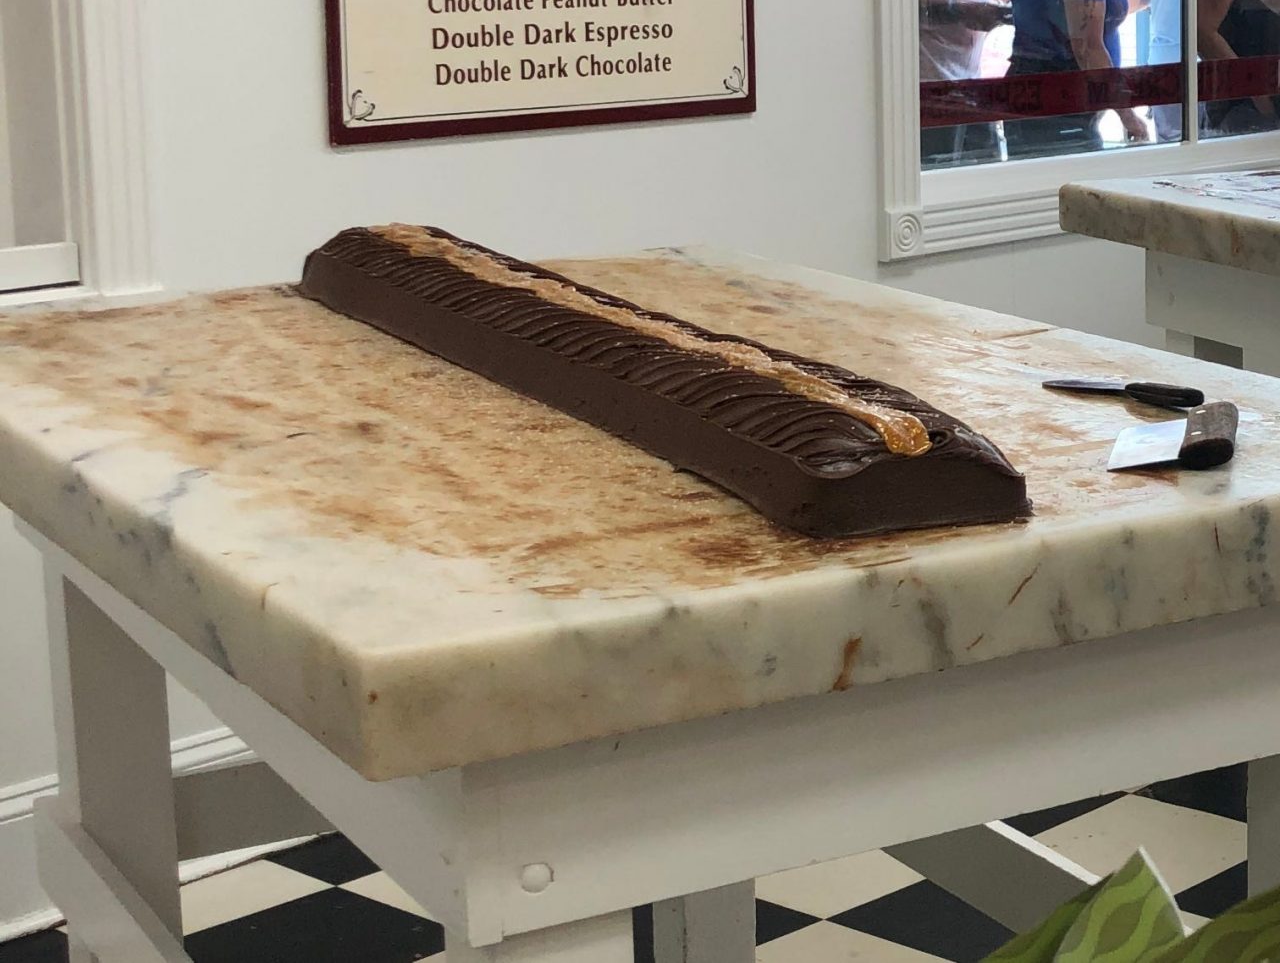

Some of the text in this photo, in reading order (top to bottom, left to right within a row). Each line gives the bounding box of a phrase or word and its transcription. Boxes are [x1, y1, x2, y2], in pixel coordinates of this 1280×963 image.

[432, 21, 673, 50] Double Dark Espresso
[435, 51, 672, 86] Double Dark Chocolate
